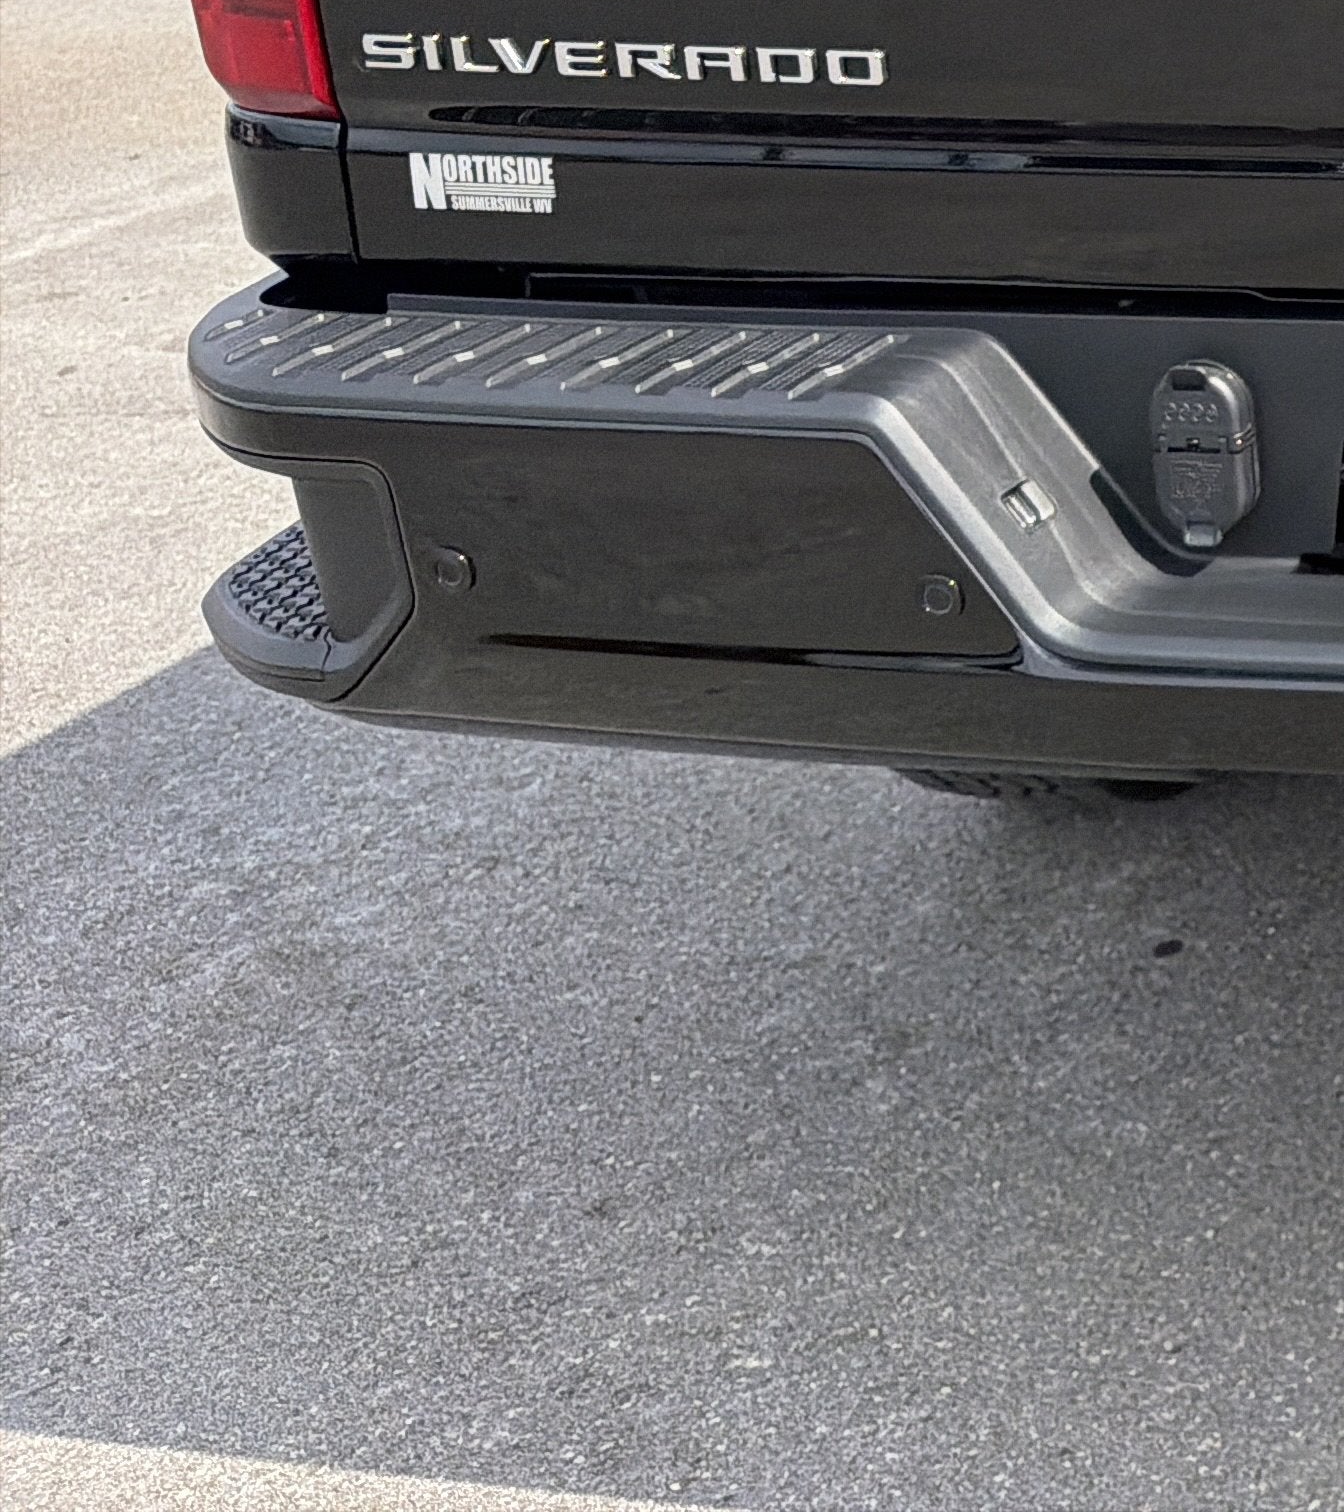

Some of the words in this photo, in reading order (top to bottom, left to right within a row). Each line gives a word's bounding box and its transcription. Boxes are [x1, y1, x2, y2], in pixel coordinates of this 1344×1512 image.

[362, 32, 890, 86] SILVERADO
[409, 152, 555, 210] NORTHSIDE
[451, 195, 533, 213] SUMMERSVILLE
[533, 198, 553, 214] WV
